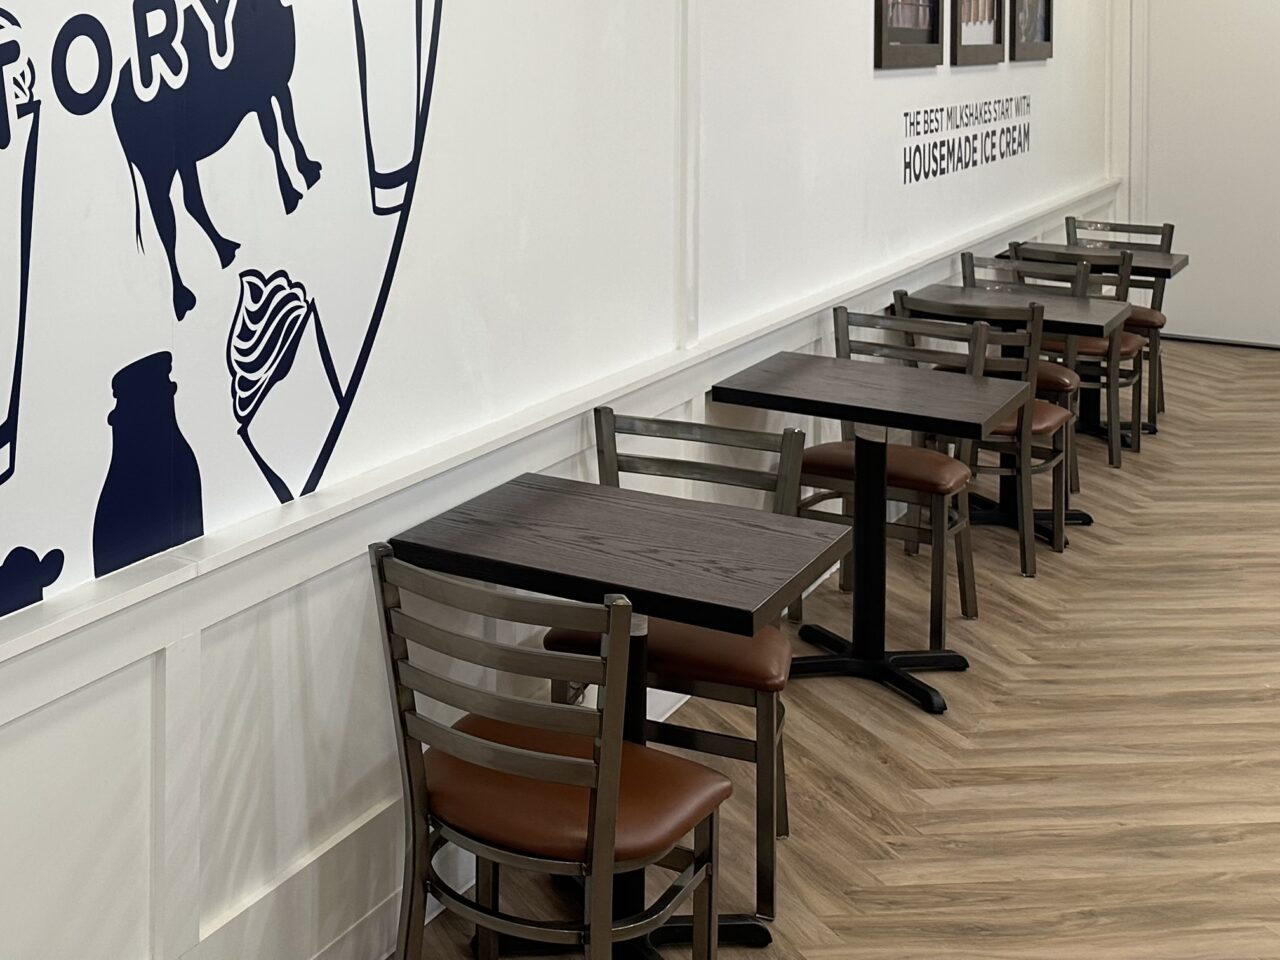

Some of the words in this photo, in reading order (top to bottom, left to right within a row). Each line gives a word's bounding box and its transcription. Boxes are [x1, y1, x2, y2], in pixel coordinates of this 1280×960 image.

[903, 111, 921, 138] THE
[923, 108, 944, 135] BEST
[946, 101, 992, 131] MILKSHAKES
[993, 97, 1013, 122] START
[1014, 95, 1031, 118] WITH
[903, 134, 978, 185] HOUSEMADE
[980, 130, 996, 165] ICE
[999, 122, 1030, 160] CREAM
